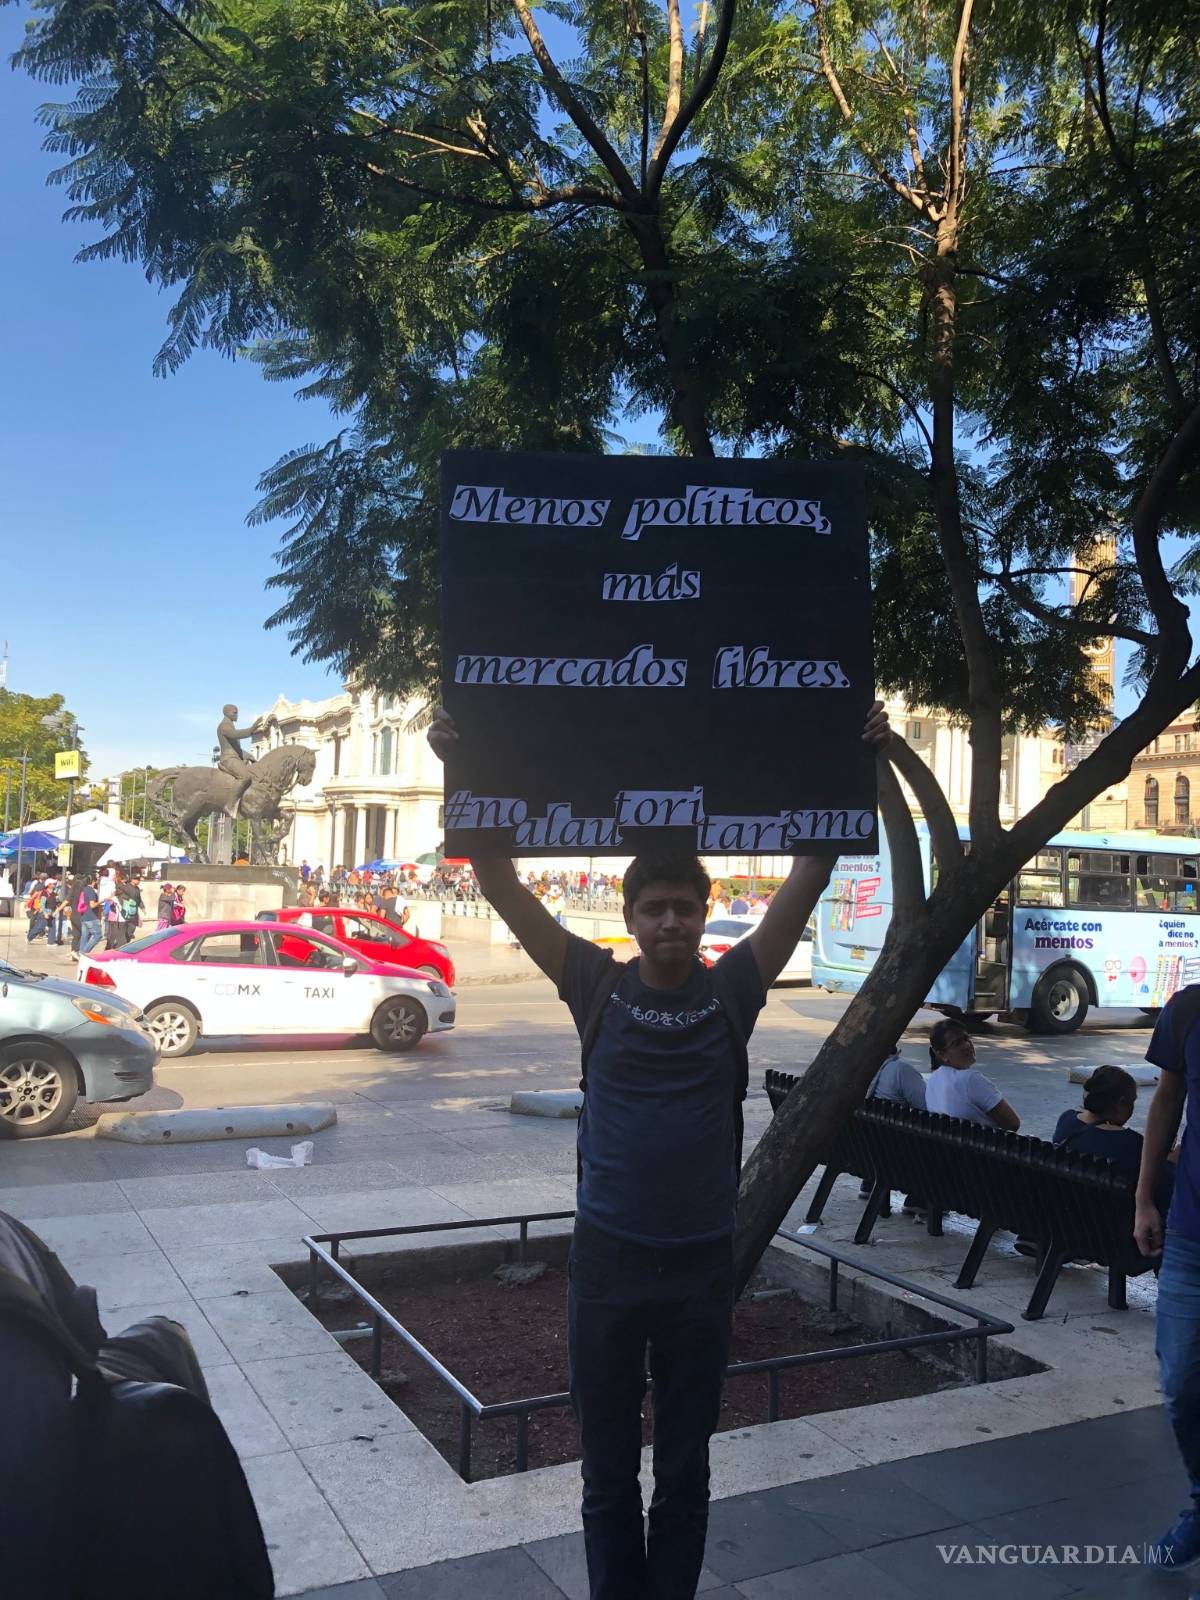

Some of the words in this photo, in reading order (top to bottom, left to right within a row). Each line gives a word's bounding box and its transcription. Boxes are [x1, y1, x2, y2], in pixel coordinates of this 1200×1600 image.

[452, 487, 607, 525] Menos
[622, 487, 830, 539] políticos,
[605, 565, 699, 600] más
[458, 645, 686, 687] mercados
[713, 646, 849, 688] libres.
[840, 862, 873, 872] mentos
[1025, 918, 1079, 931] Acércate
[1081, 922, 1102, 932] con
[1159, 920, 1185, 930] ¿quién
[1167, 930, 1183, 938] dice
[1035, 935, 1094, 949] mentos
[1165, 940, 1193, 948] mentos
[214, 983, 261, 996] CDMX
[304, 987, 335, 999] TAXI
